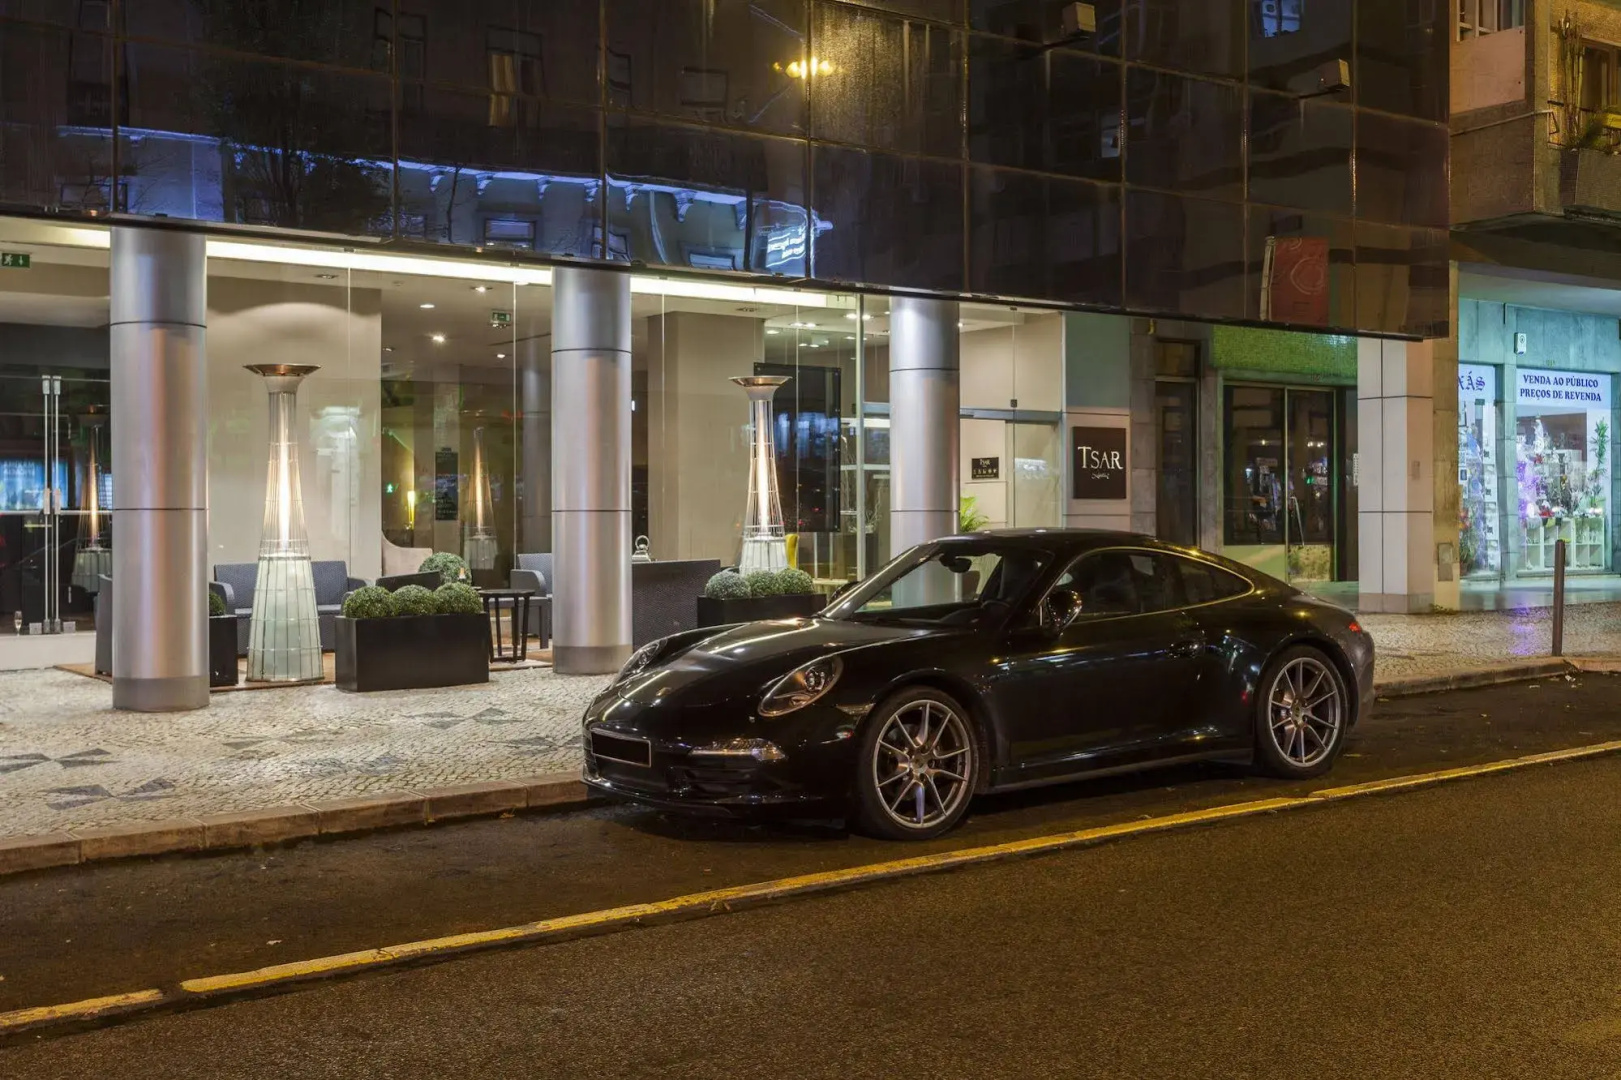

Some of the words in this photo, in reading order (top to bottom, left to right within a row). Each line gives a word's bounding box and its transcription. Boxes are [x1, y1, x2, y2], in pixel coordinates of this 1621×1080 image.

[1523, 374, 1551, 385] VENDA
[1553, 377, 1564, 386] AO
[1566, 376, 1599, 388] PÚBLICO
[1520, 388, 1551, 400] PREÇOS
[1553, 390, 1563, 399] DE
[1565, 391, 1602, 402] REVENDA
